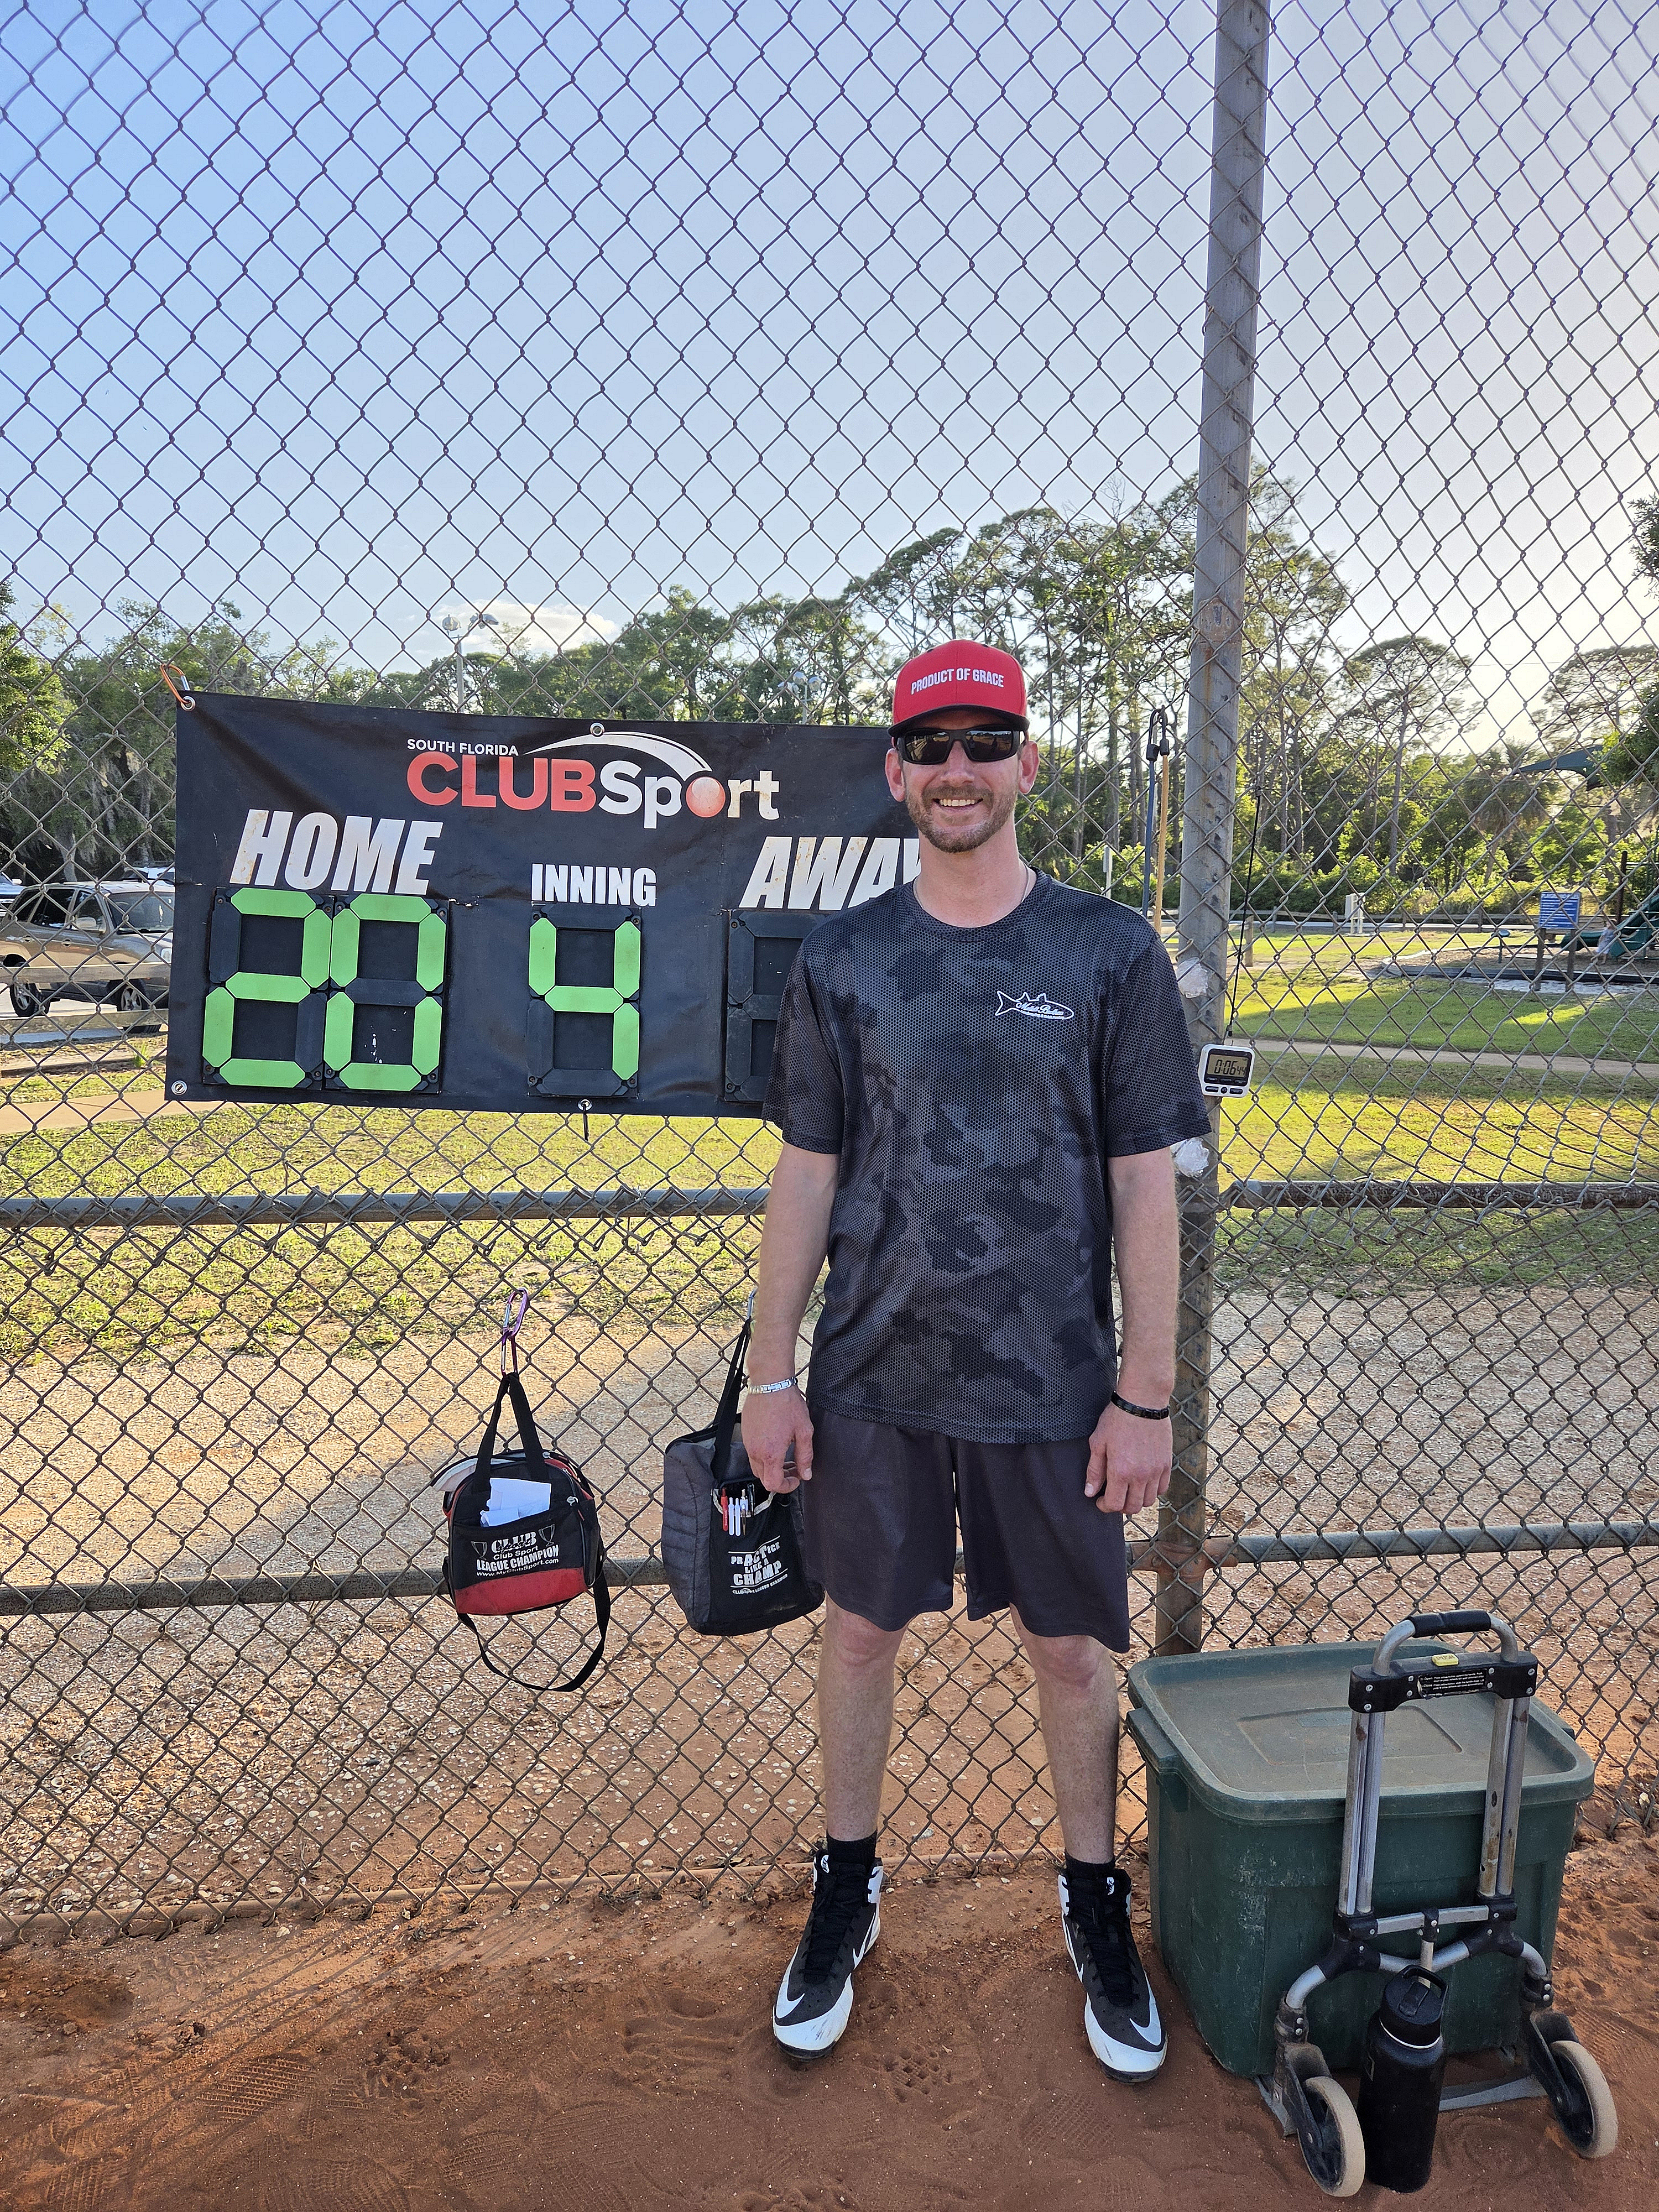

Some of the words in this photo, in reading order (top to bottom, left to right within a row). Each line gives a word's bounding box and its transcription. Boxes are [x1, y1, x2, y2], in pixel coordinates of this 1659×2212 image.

[911, 669, 954, 695] PRODUCT
[956, 667, 971, 681] OF
[972, 669, 1004, 687] GRACE
[407, 738, 455, 753] SOUTH
[460, 743, 519, 757] FLORIDA
[229, 808, 443, 895] HOME
[531, 863, 657, 906] INNING
[202, 887, 446, 1092] 20
[528, 917, 641, 1081] 4
[477, 1559, 509, 1572] LEAGUE
[510, 1545, 559, 1568] CHAMPION
[515, 1546, 539, 1556] Sport
[477, 1558, 559, 1577] www.MyClubSport.com
[733, 1560, 782, 1585] CHAMP
[744, 1561, 763, 1574] LIKE
[764, 1557, 769, 1566] A
